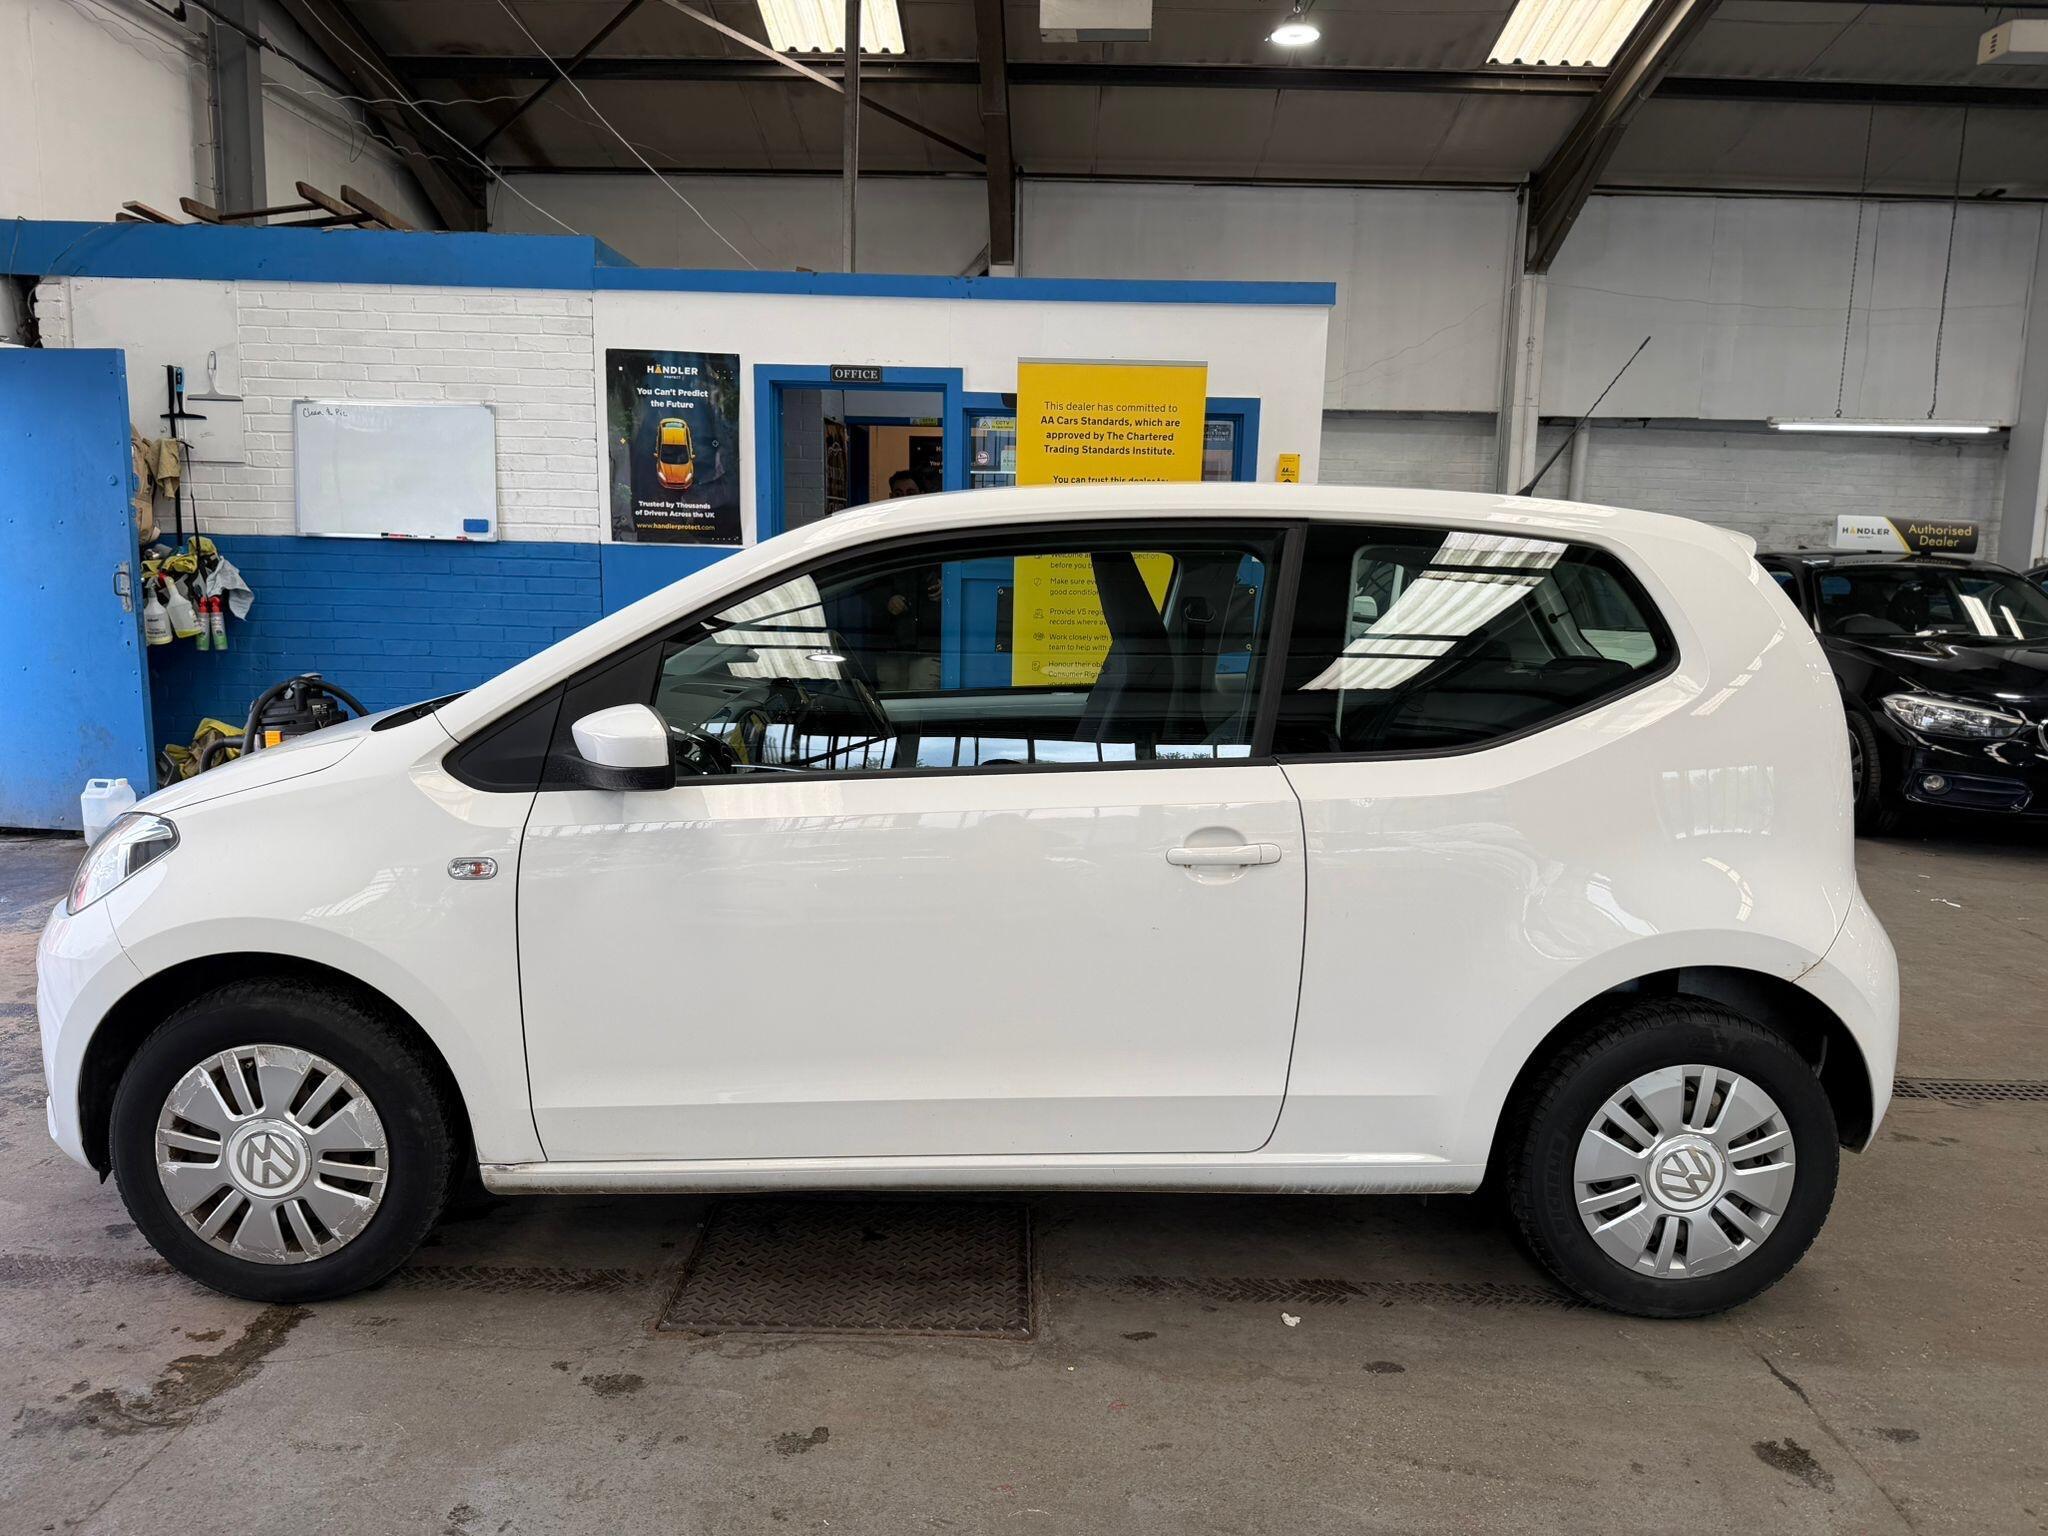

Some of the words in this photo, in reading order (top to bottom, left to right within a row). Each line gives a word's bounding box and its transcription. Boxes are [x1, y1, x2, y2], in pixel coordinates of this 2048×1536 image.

[835, 369, 878, 379] OFFICE
[637, 387, 652, 395] You
[654, 388, 676, 396] Can't
[678, 389, 708, 397] Predict
[650, 400, 665, 408] the
[666, 400, 694, 409] Future
[1044, 401, 1064, 411] This
[1066, 401, 1095, 412] dealer
[1097, 402, 1114, 412] has
[1116, 402, 1165, 413] committed
[1168, 403, 1178, 413] to
[1040, 416, 1055, 425] AA
[1056, 416, 1079, 425] Cars
[1080, 416, 1133, 428] Standards,
[1135, 417, 1163, 427] which
[1165, 419, 1181, 427] are
[1046, 431, 1091, 441] approved
[1093, 431, 1105, 442] by
[1106, 431, 1125, 441] The
[1126, 432, 1174, 442] Chartered
[1044, 444, 1080, 455] Trading
[1082, 445, 1130, 455] Standards
[1132, 446, 1175, 456] Institute.
[1053, 475, 1069, 484] You
[1071, 476, 1086, 484] can
[665, 501, 675, 509] by
[1908, 523, 1972, 536] Authorised
[1919, 535, 1960, 547] Dealer
[1051, 561, 1073, 569] before
[1074, 562, 1087, 570] you
[1050, 577, 1069, 585] Make
[1050, 588, 1068, 597] good
[1049, 607, 1076, 615] Provide
[1049, 633, 1068, 641] Work
[1069, 633, 1092, 641] closely
[1076, 644, 1091, 652] help
